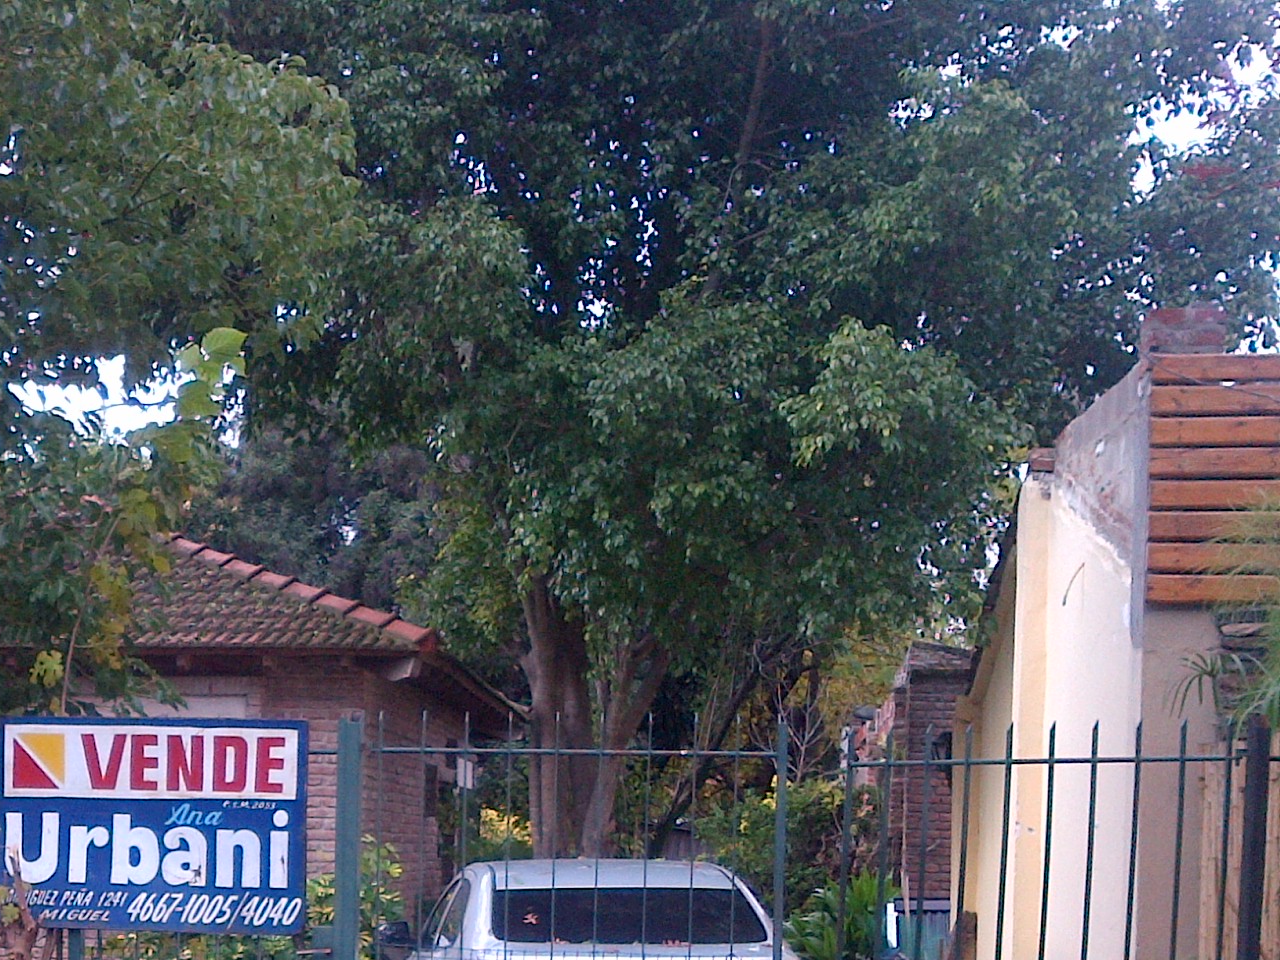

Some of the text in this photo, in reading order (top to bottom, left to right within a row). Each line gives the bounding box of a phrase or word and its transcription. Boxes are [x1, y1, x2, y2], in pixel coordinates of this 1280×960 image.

[82, 734, 286, 792] VENDE
[165, 804, 222, 826] Ana
[5, 809, 289, 888] Urbani
[60, 888, 94, 906] PEÑA
[128, 892, 302, 928] 4667-1005/4040
[40, 909, 112, 921] MIGUEL
